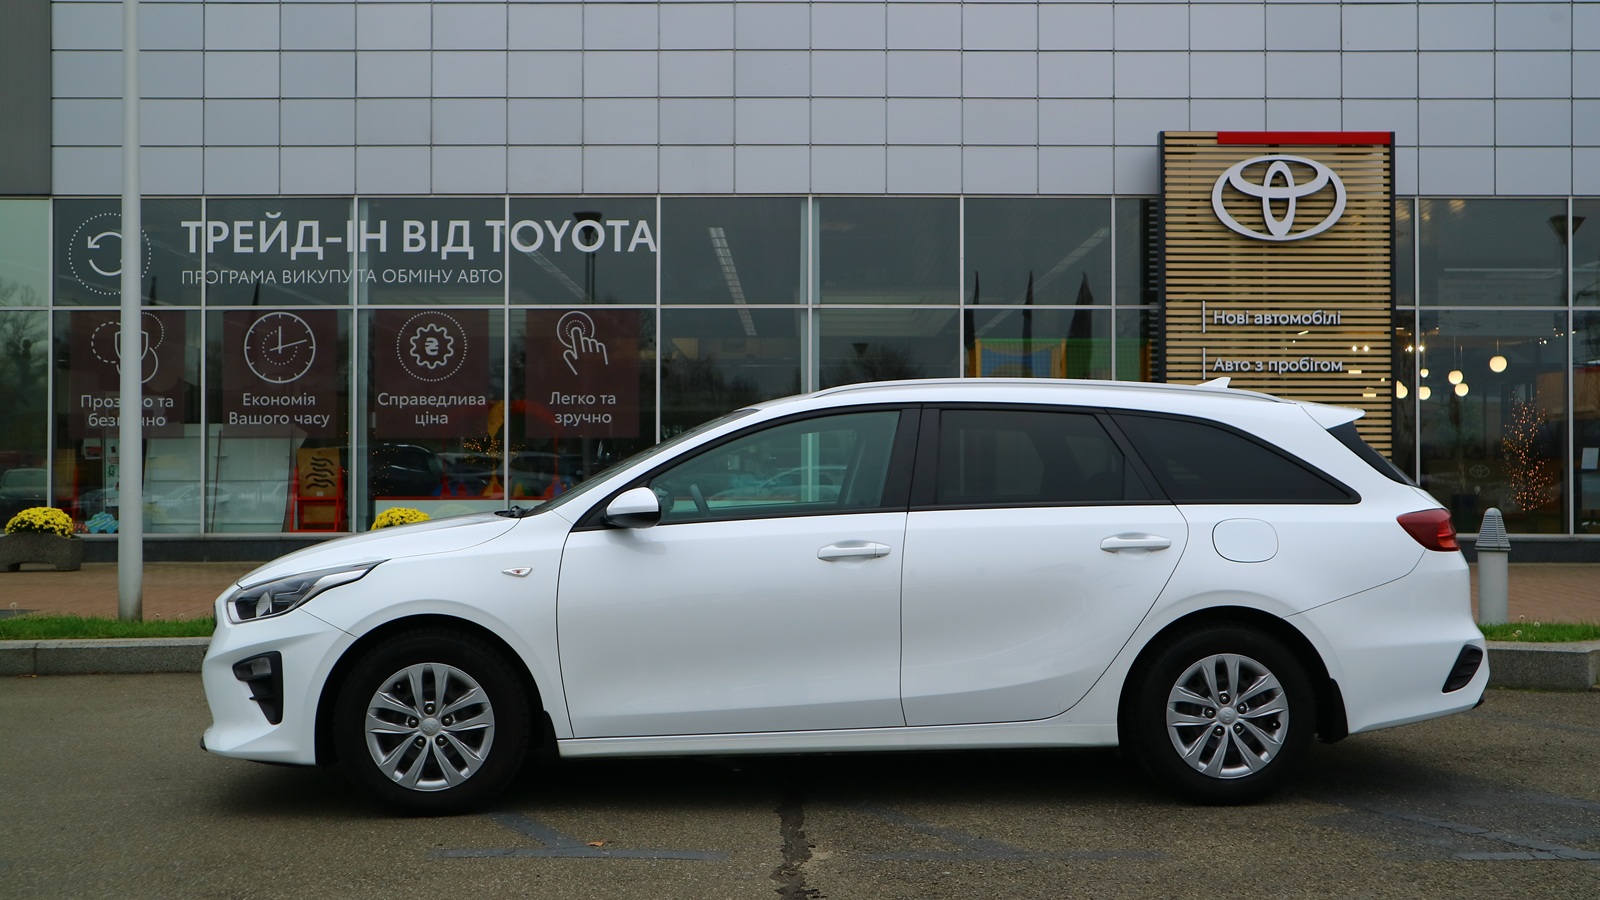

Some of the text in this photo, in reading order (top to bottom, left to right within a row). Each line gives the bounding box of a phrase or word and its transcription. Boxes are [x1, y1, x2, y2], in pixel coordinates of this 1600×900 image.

[181, 211, 658, 261] ТРЕЙД-ІН ВІД TOYOTA
[182, 268, 503, 284] ПРОГРАМА ВИКУПУ ТА ОБМІНУ АВТО
[1213, 309, 1341, 325] Нові автомобілі
[1213, 356, 1343, 375] Авто з пробігом
[81, 395, 174, 411] Прозо та
[242, 392, 316, 406] Економія
[377, 392, 486, 409] Справедлива
[549, 391, 616, 405] Легко та
[88, 412, 166, 427] безно
[229, 411, 330, 428] Вашого часу
[415, 411, 449, 427] ціна
[554, 413, 612, 427] зручно
